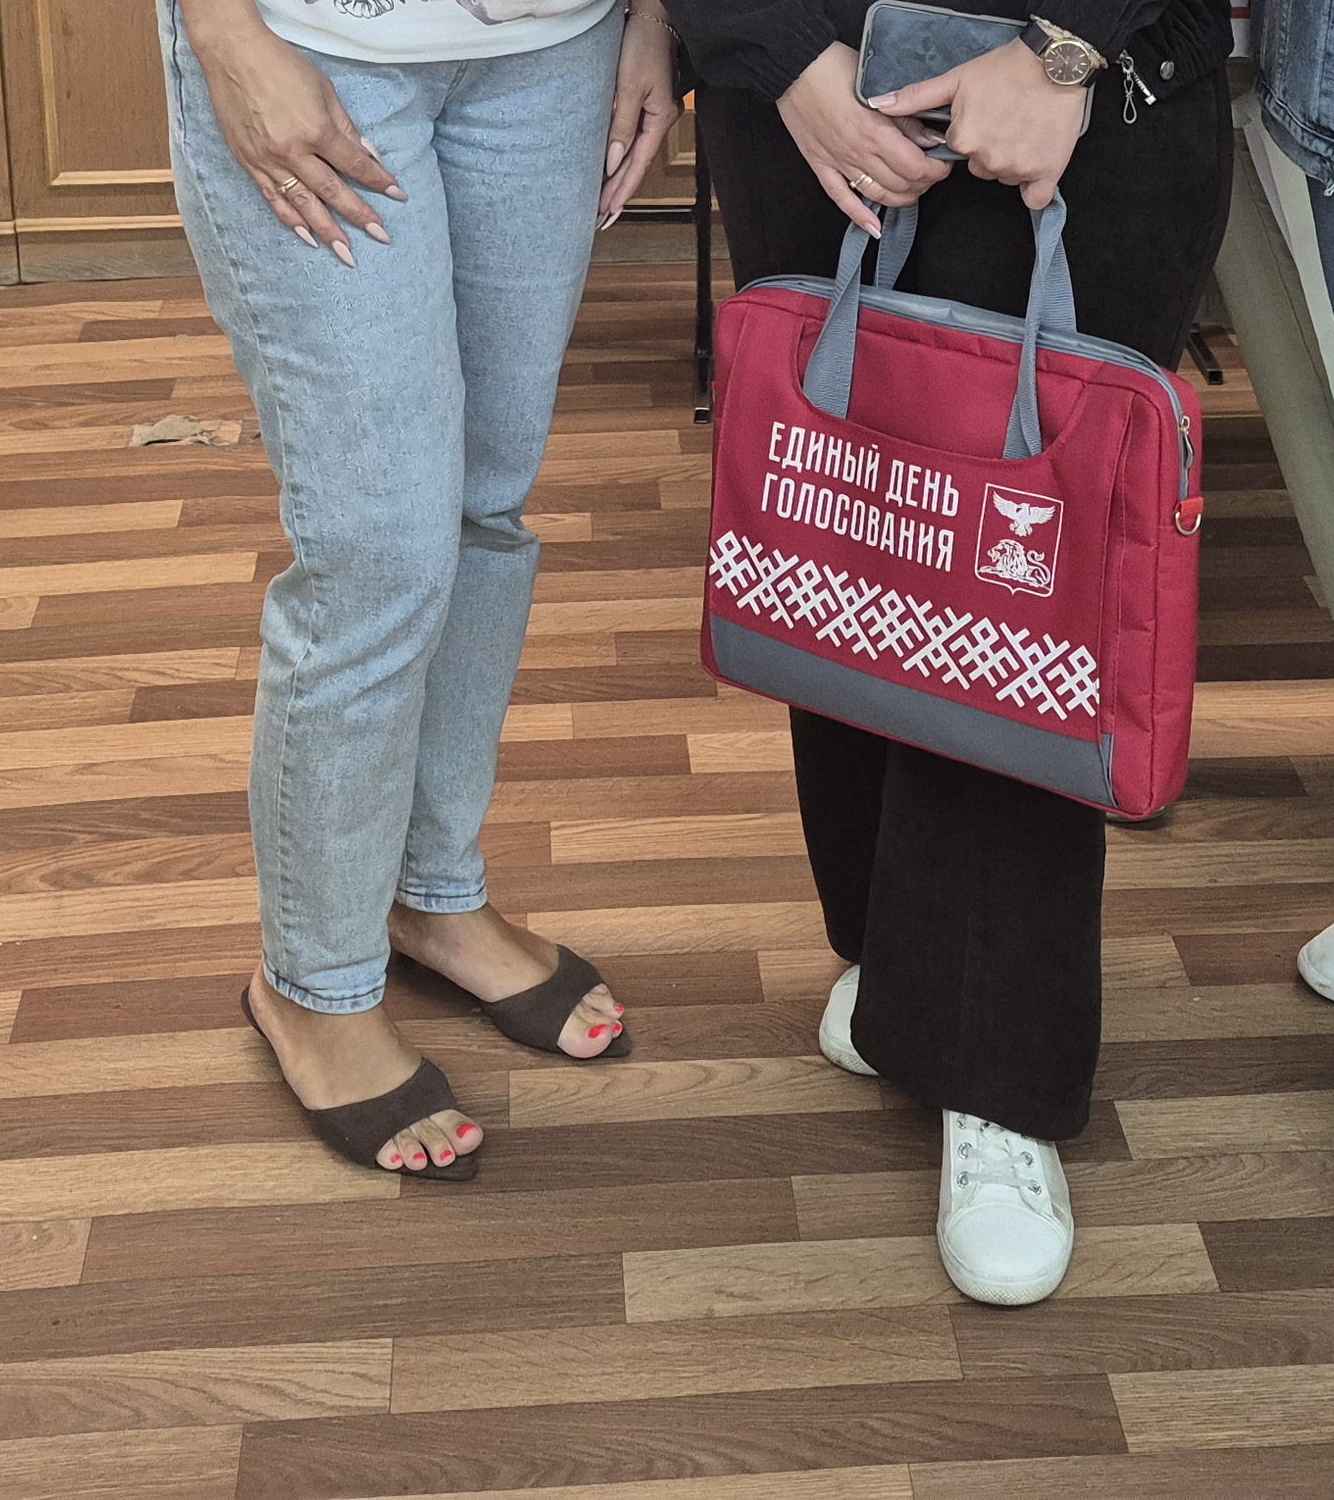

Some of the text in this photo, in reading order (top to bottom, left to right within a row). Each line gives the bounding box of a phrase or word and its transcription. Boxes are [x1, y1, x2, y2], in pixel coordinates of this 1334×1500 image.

[768, 421, 959, 517] ЕДИНЫЙ ДЕНЬ
[761, 472, 954, 572] ГОЛОСОВАНИЯ
